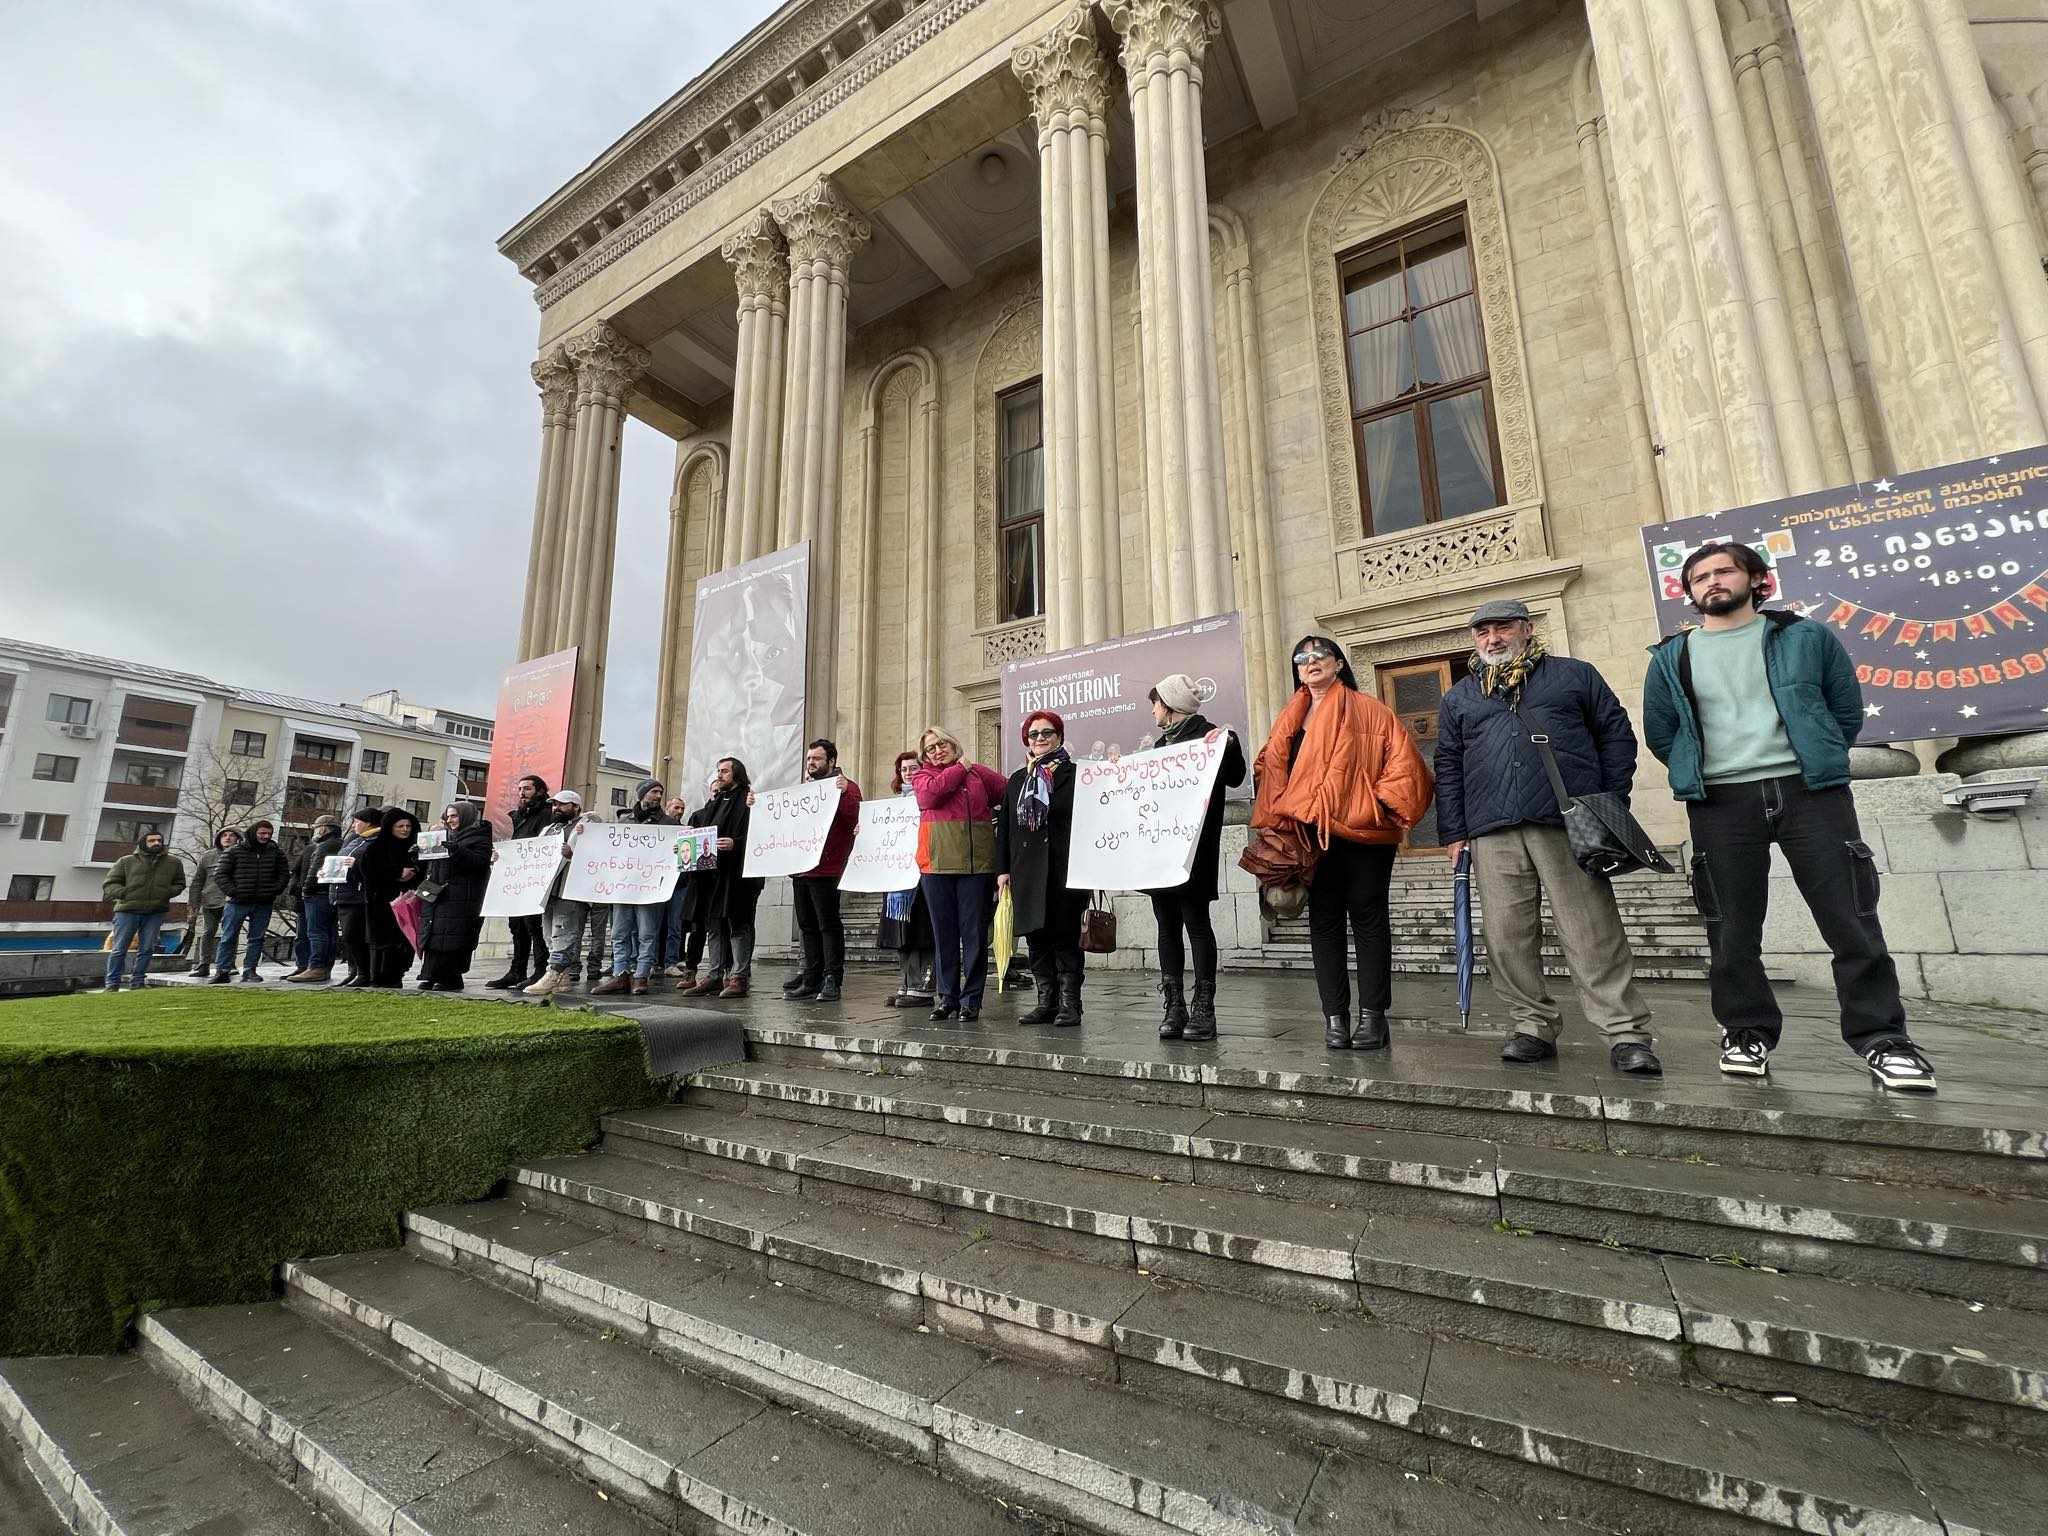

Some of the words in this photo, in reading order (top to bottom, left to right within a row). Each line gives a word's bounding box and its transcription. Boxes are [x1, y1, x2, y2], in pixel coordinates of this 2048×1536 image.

[1875, 488, 1932, 508] ლადო
[1940, 466, 2048, 496] მესხიშვილ
[1829, 503, 1936, 531] სახელობის
[1944, 485, 2023, 510] თეატრი
[1814, 544, 1858, 568] 28
[1848, 555, 1932, 579] 15:00
[1927, 561, 2020, 587] 18:00
[1018, 673, 1122, 714] TESTOSTERONE
[767, 784, 827, 821] შეწყდეს
[1099, 782, 1146, 805] გიორგი
[872, 806, 920, 827] სიმართლ
[1139, 800, 1159, 820] და
[608, 826, 666, 849] შეწყდეს
[1095, 830, 1129, 850] კაკო
